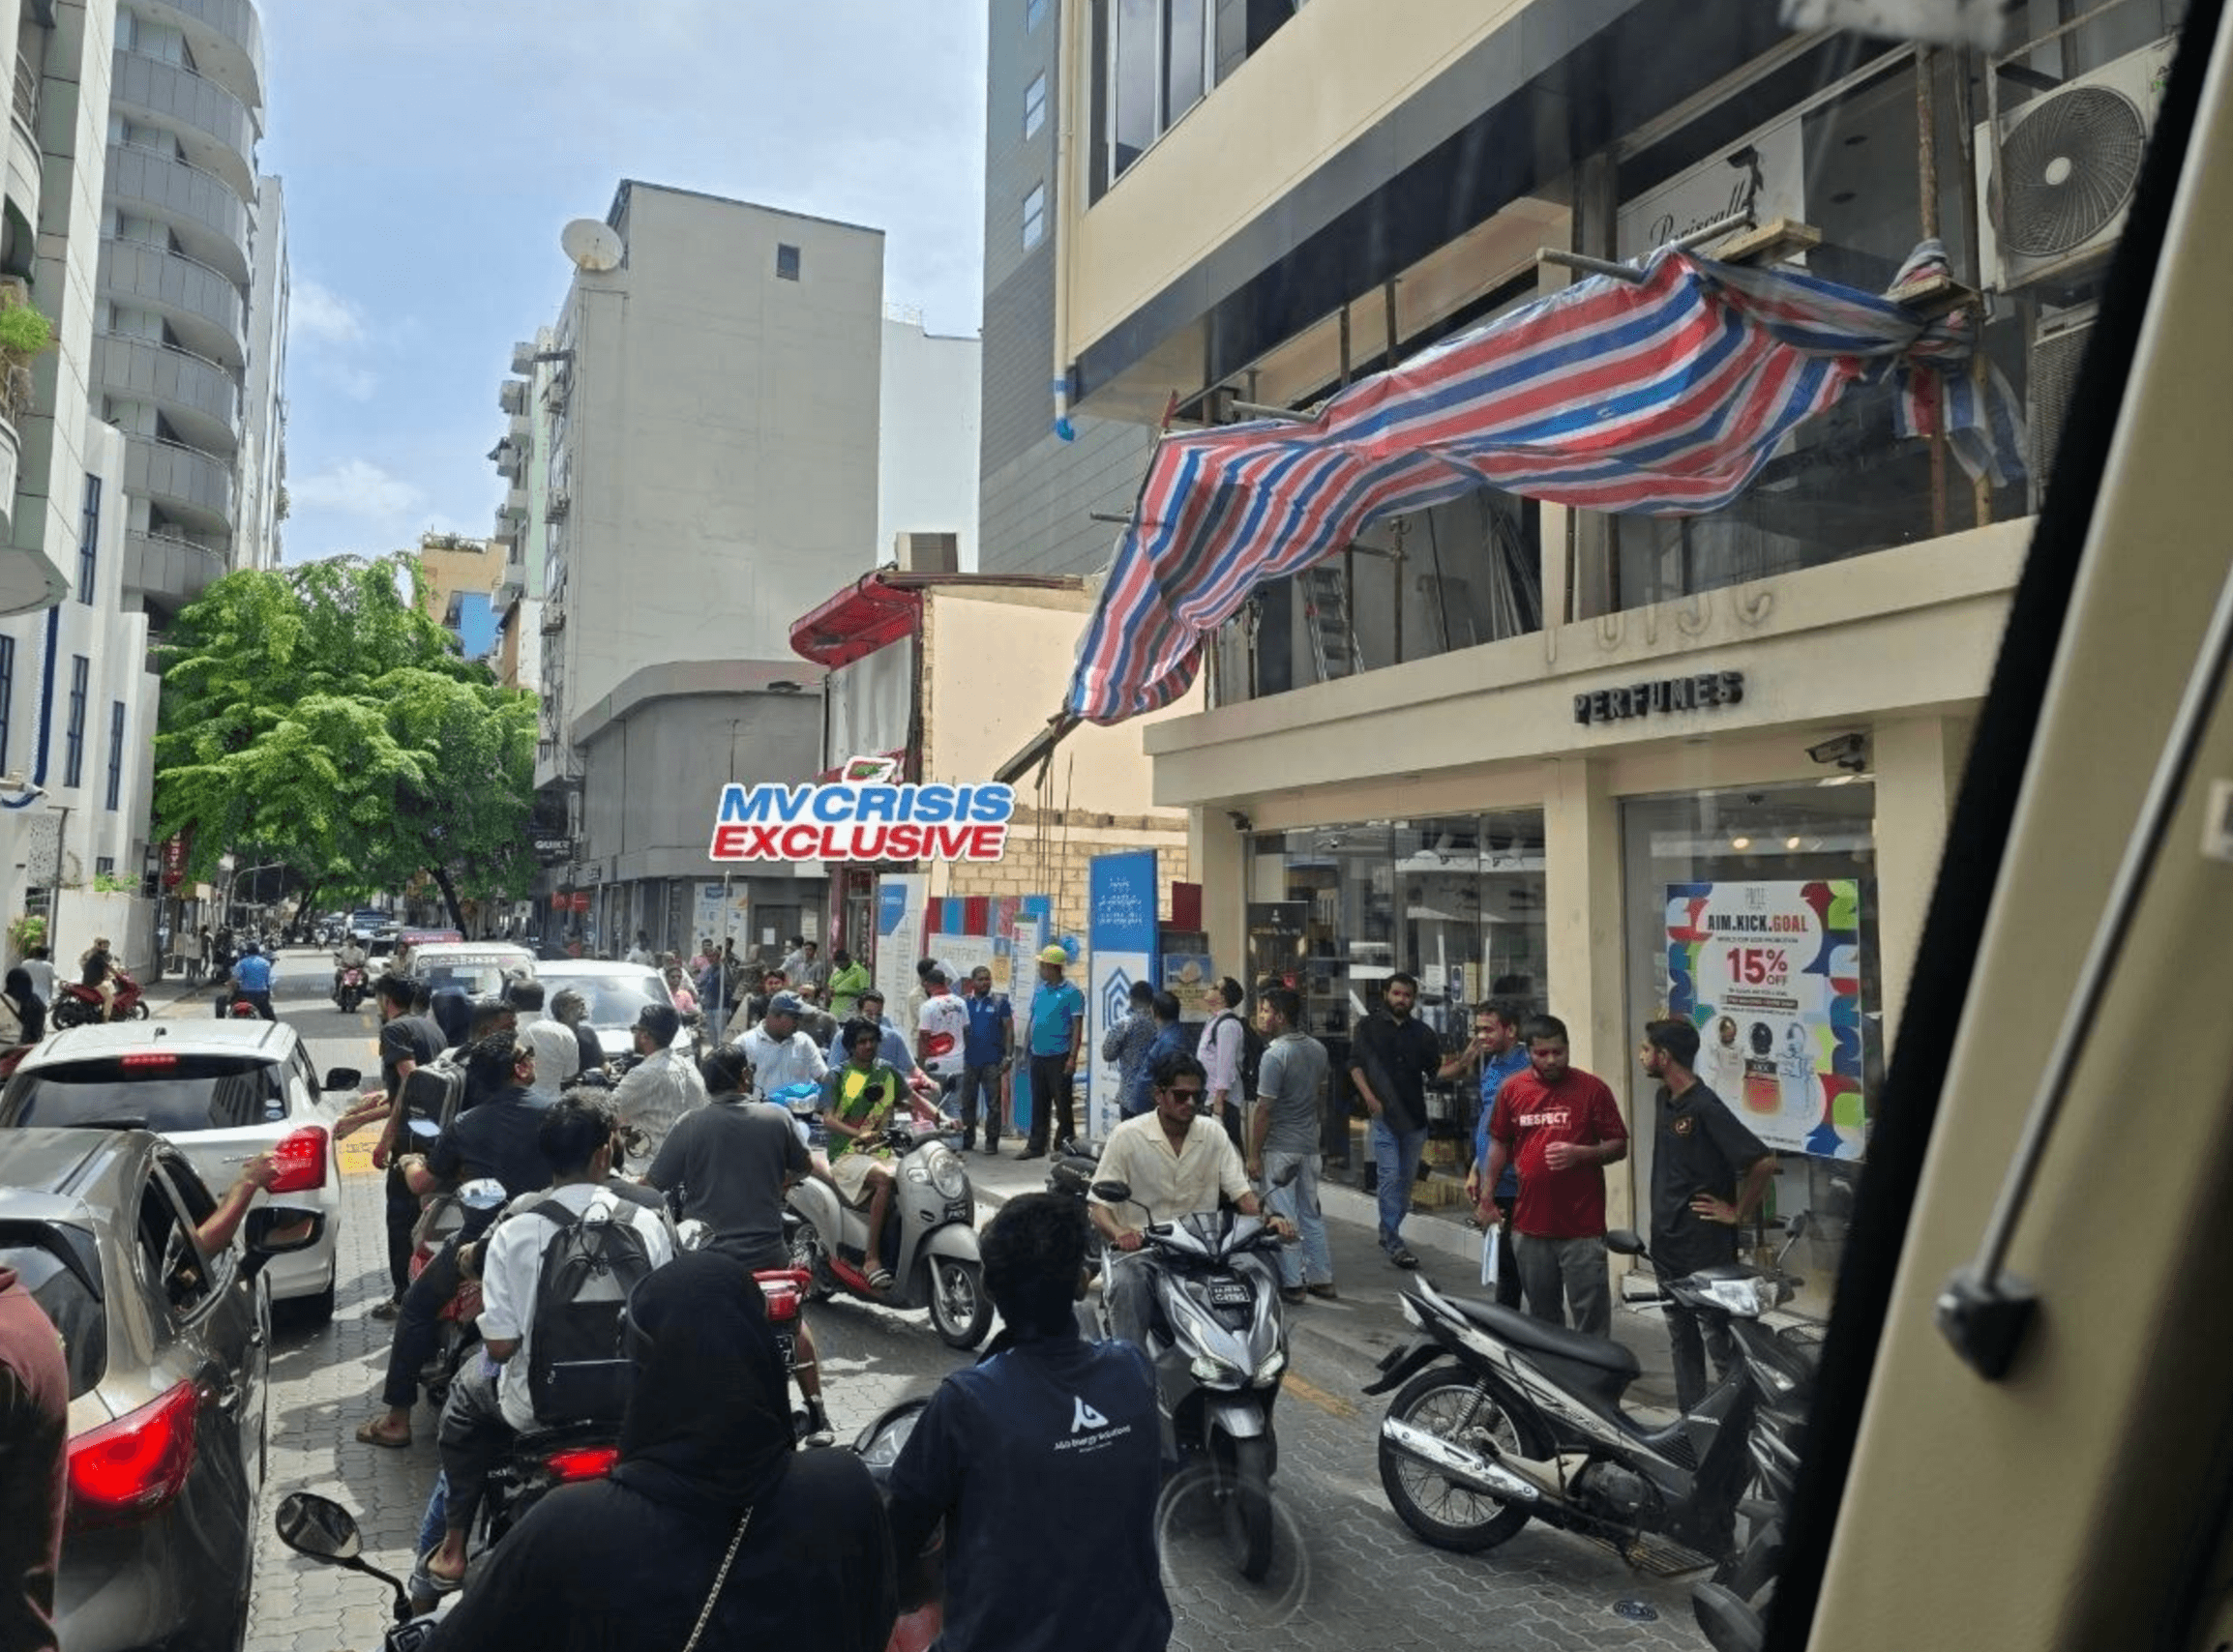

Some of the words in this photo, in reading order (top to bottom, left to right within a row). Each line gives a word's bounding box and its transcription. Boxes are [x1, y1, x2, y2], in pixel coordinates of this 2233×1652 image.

[1574, 671, 1744, 725] PERFUMES
[1726, 947, 1788, 985] 15%
[1766, 974, 1787, 986] OFF
[1520, 1111, 1568, 1127] RESPECT
